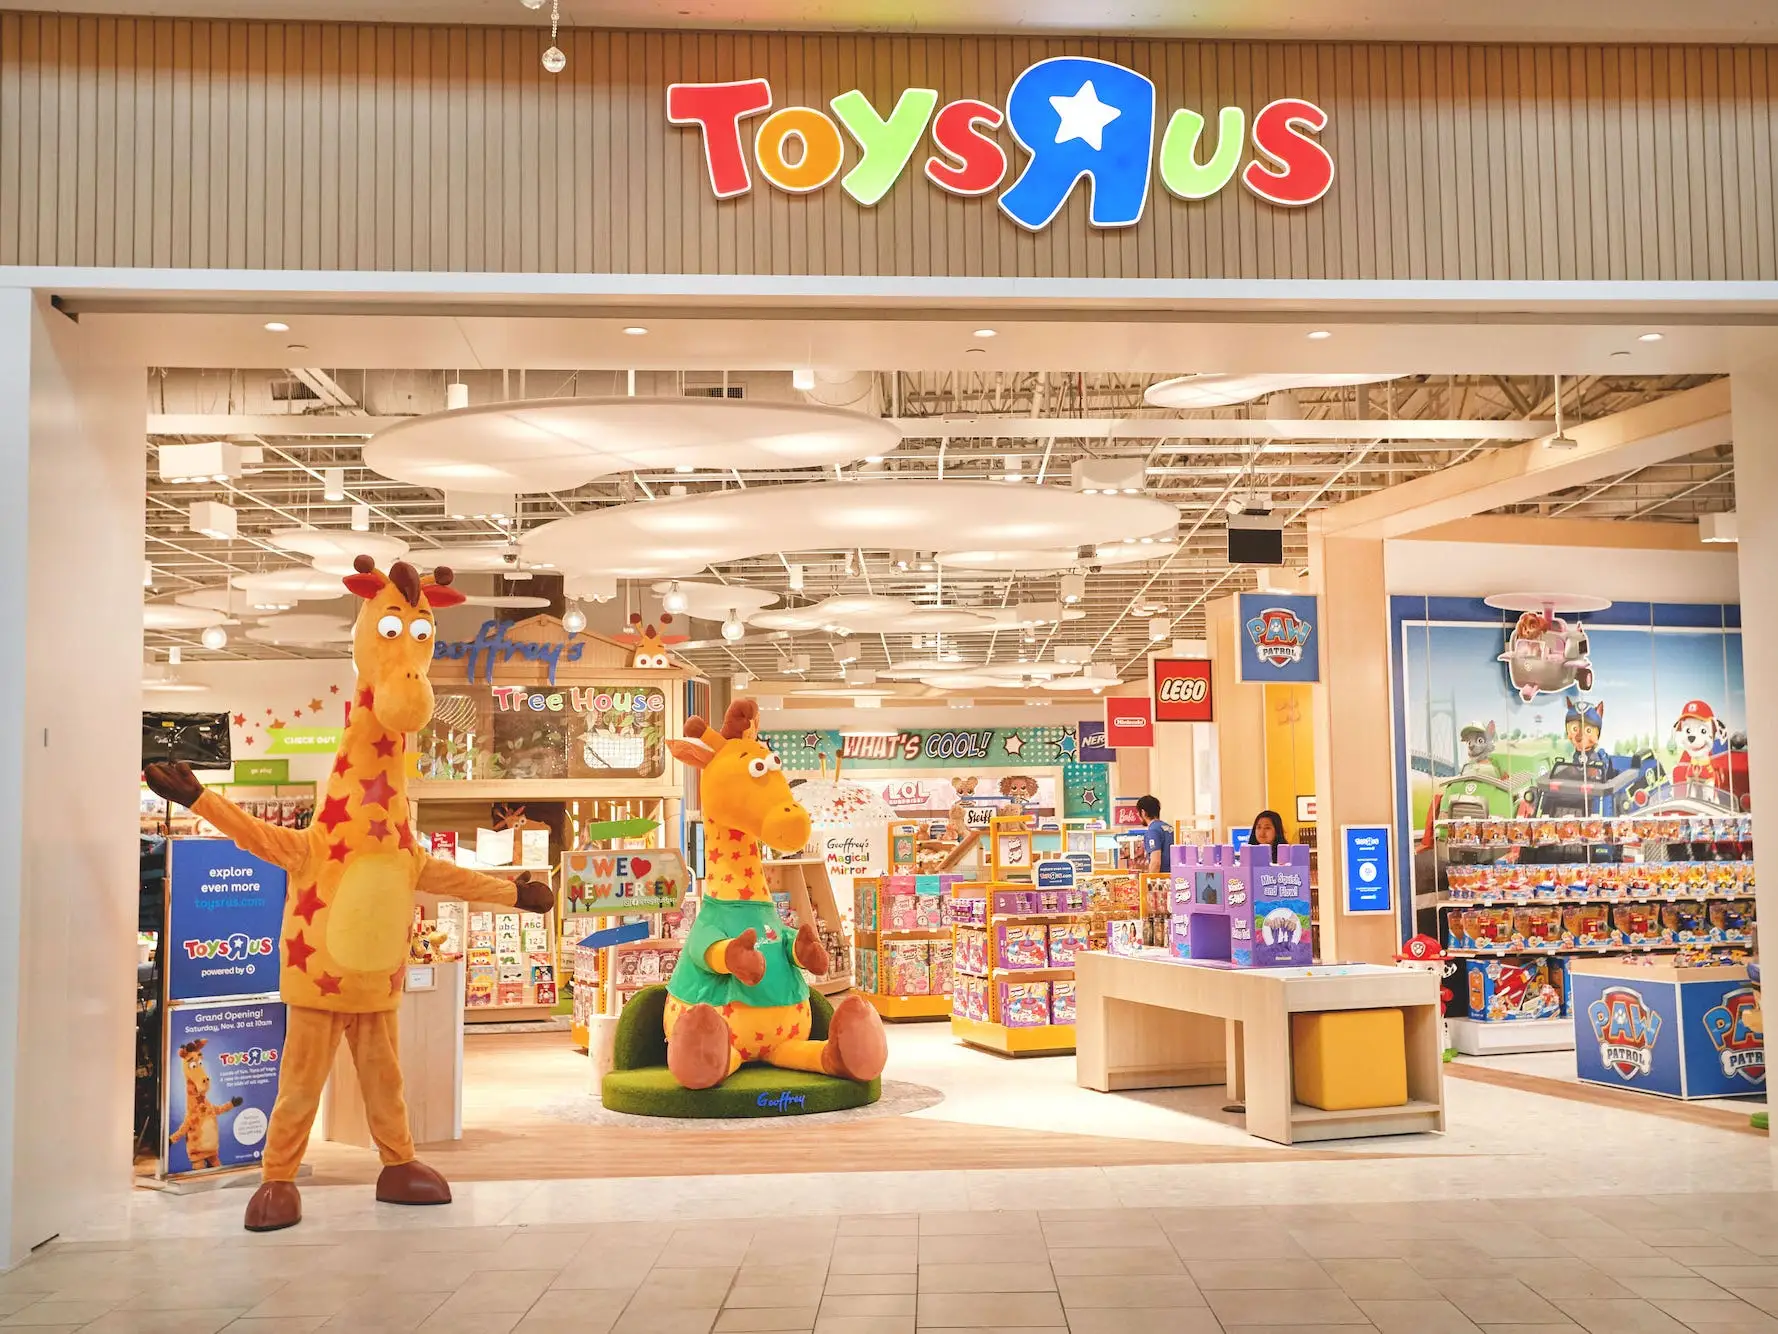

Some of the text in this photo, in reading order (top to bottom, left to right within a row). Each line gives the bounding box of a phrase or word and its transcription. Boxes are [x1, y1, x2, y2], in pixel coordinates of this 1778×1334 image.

[1246, 616, 1312, 647] PAW
[433, 620, 585, 686] eoffrey's
[1262, 645, 1297, 657] PATROL
[1160, 678, 1207, 703] LEGO
[492, 686, 664, 712] Tree House
[283, 736, 336, 744] CHECK OUT
[843, 731, 992, 760] WHAT'S COOL!
[1081, 735, 1105, 748] NER
[967, 810, 992, 824] Steiff
[827, 838, 869, 854] Geoffrey's
[827, 852, 869, 865] Magical
[209, 867, 253, 879] explore
[591, 857, 628, 878] WE
[830, 866, 867, 875] Mirror
[201, 882, 260, 893] even more
[570, 879, 676, 900] NEW JERSEY
[194, 898, 265, 911] toysrus.com
[201, 966, 245, 978] powered by
[195, 1009, 264, 1023] Grand Opening!
[1587, 998, 1662, 1049] PAW
[185, 1023, 220, 1034] Saturday,
[220, 1022, 236, 1031] Nov.
[236, 1021, 245, 1029] 30
[255, 1019, 272, 1027] 10am
[1702, 1003, 1764, 1051] PA
[1606, 1047, 1645, 1064] PATROL
[1730, 1052, 1764, 1067] PATR
[757, 1091, 805, 1112] Geoffrey
